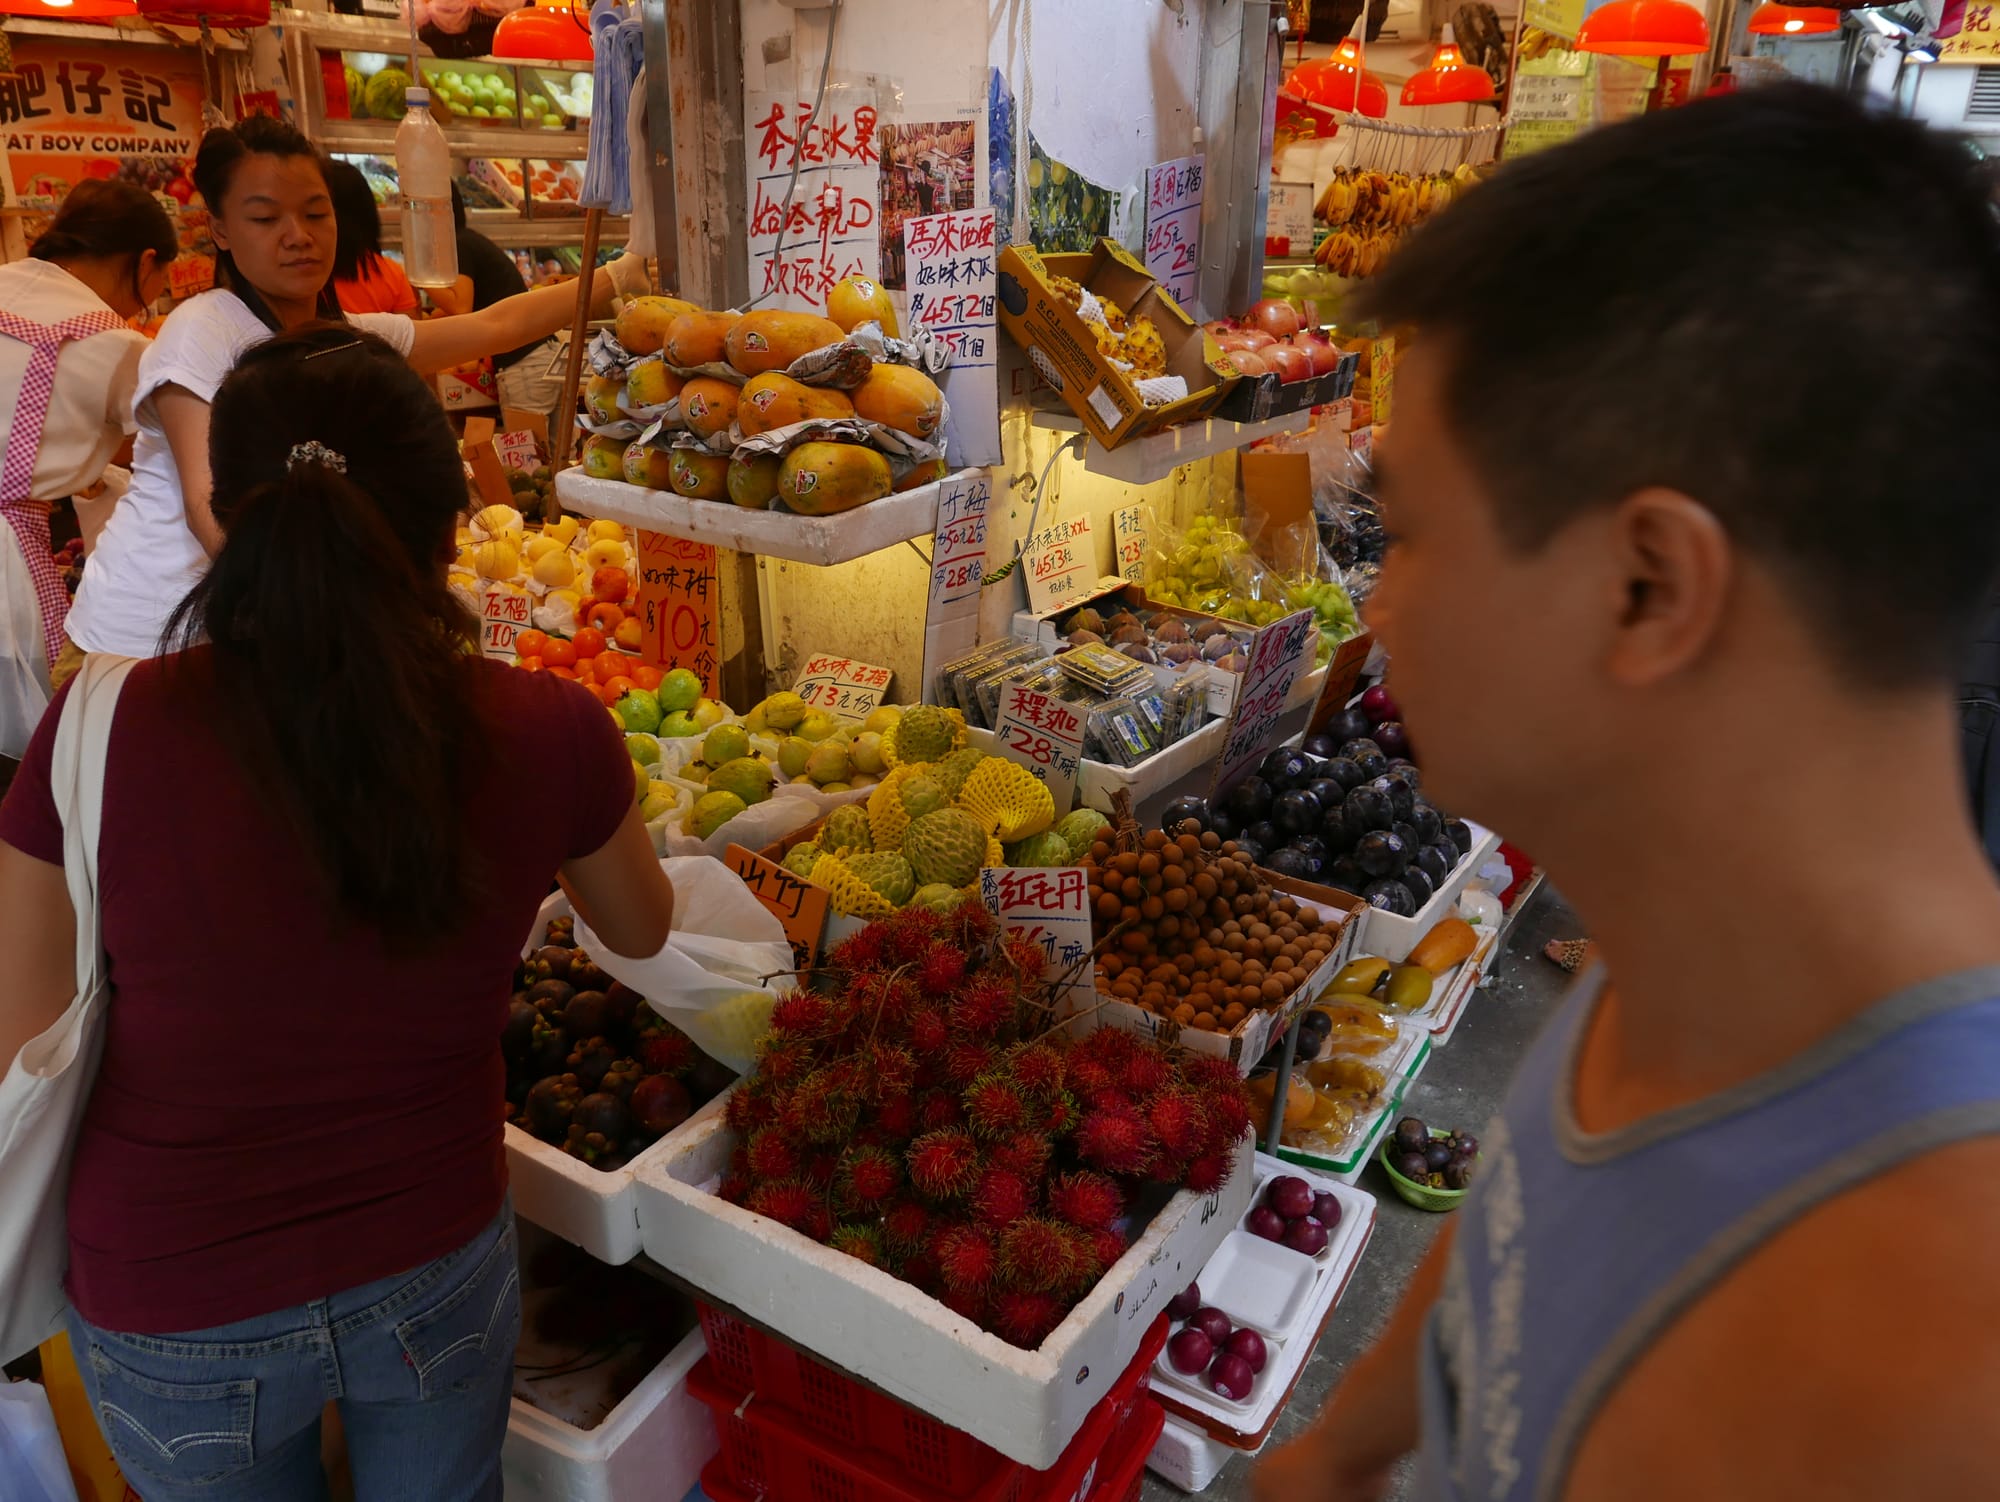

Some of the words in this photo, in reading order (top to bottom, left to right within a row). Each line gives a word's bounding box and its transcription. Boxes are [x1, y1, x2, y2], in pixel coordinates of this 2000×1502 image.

[0, 62, 177, 132] 肥仔記
[0, 133, 34, 151] AT
[42, 136, 85, 152] BOY
[91, 137, 191, 155] COMPANY
[755, 102, 880, 171] 本店水果
[907, 214, 995, 260] 馬來西亞
[916, 256, 995, 289] 好味木瓜
[484, 592, 529, 621] 石榴
